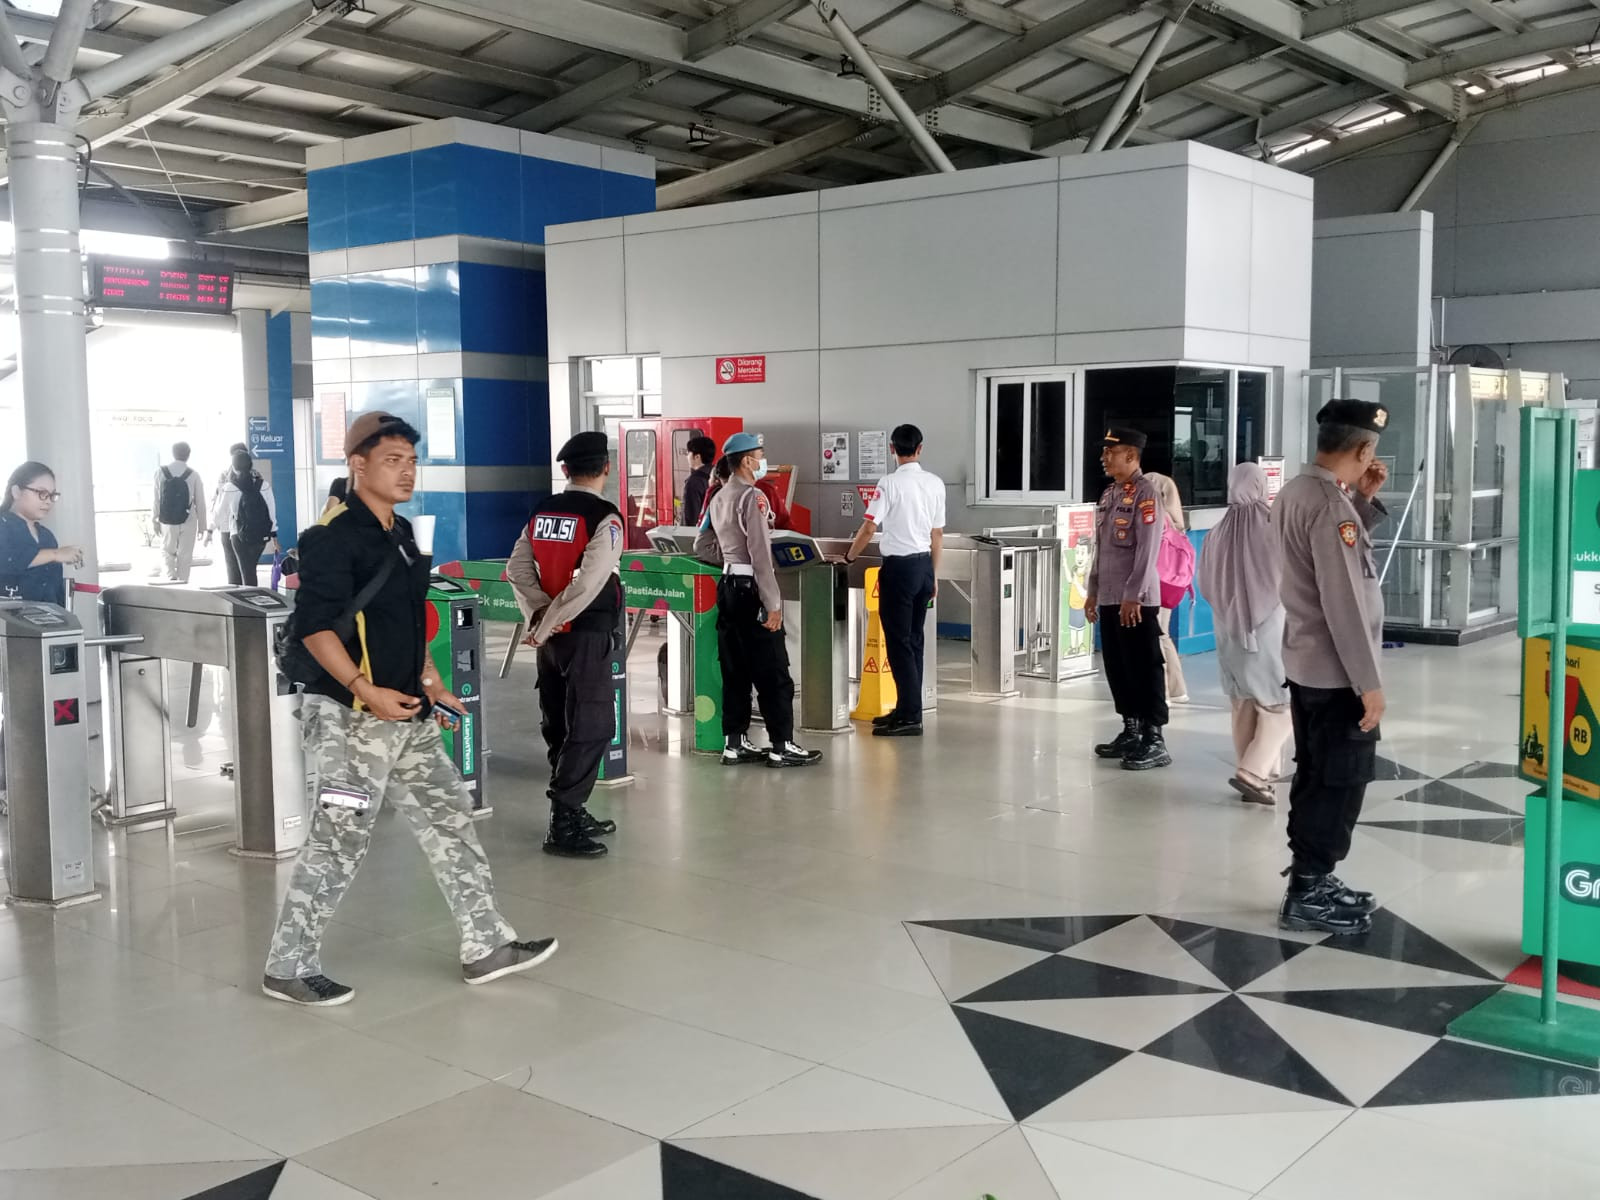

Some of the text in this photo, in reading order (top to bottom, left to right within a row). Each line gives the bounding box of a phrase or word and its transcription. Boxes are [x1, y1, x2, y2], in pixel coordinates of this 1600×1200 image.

[737, 358, 763, 368] Dilarang
[260, 433, 283, 442] Keluar
[534, 517, 576, 540] POLISI
[1573, 550, 1600, 562] ukk
[493, 598, 519, 608] #Past
[1573, 727, 1588, 744] RB
